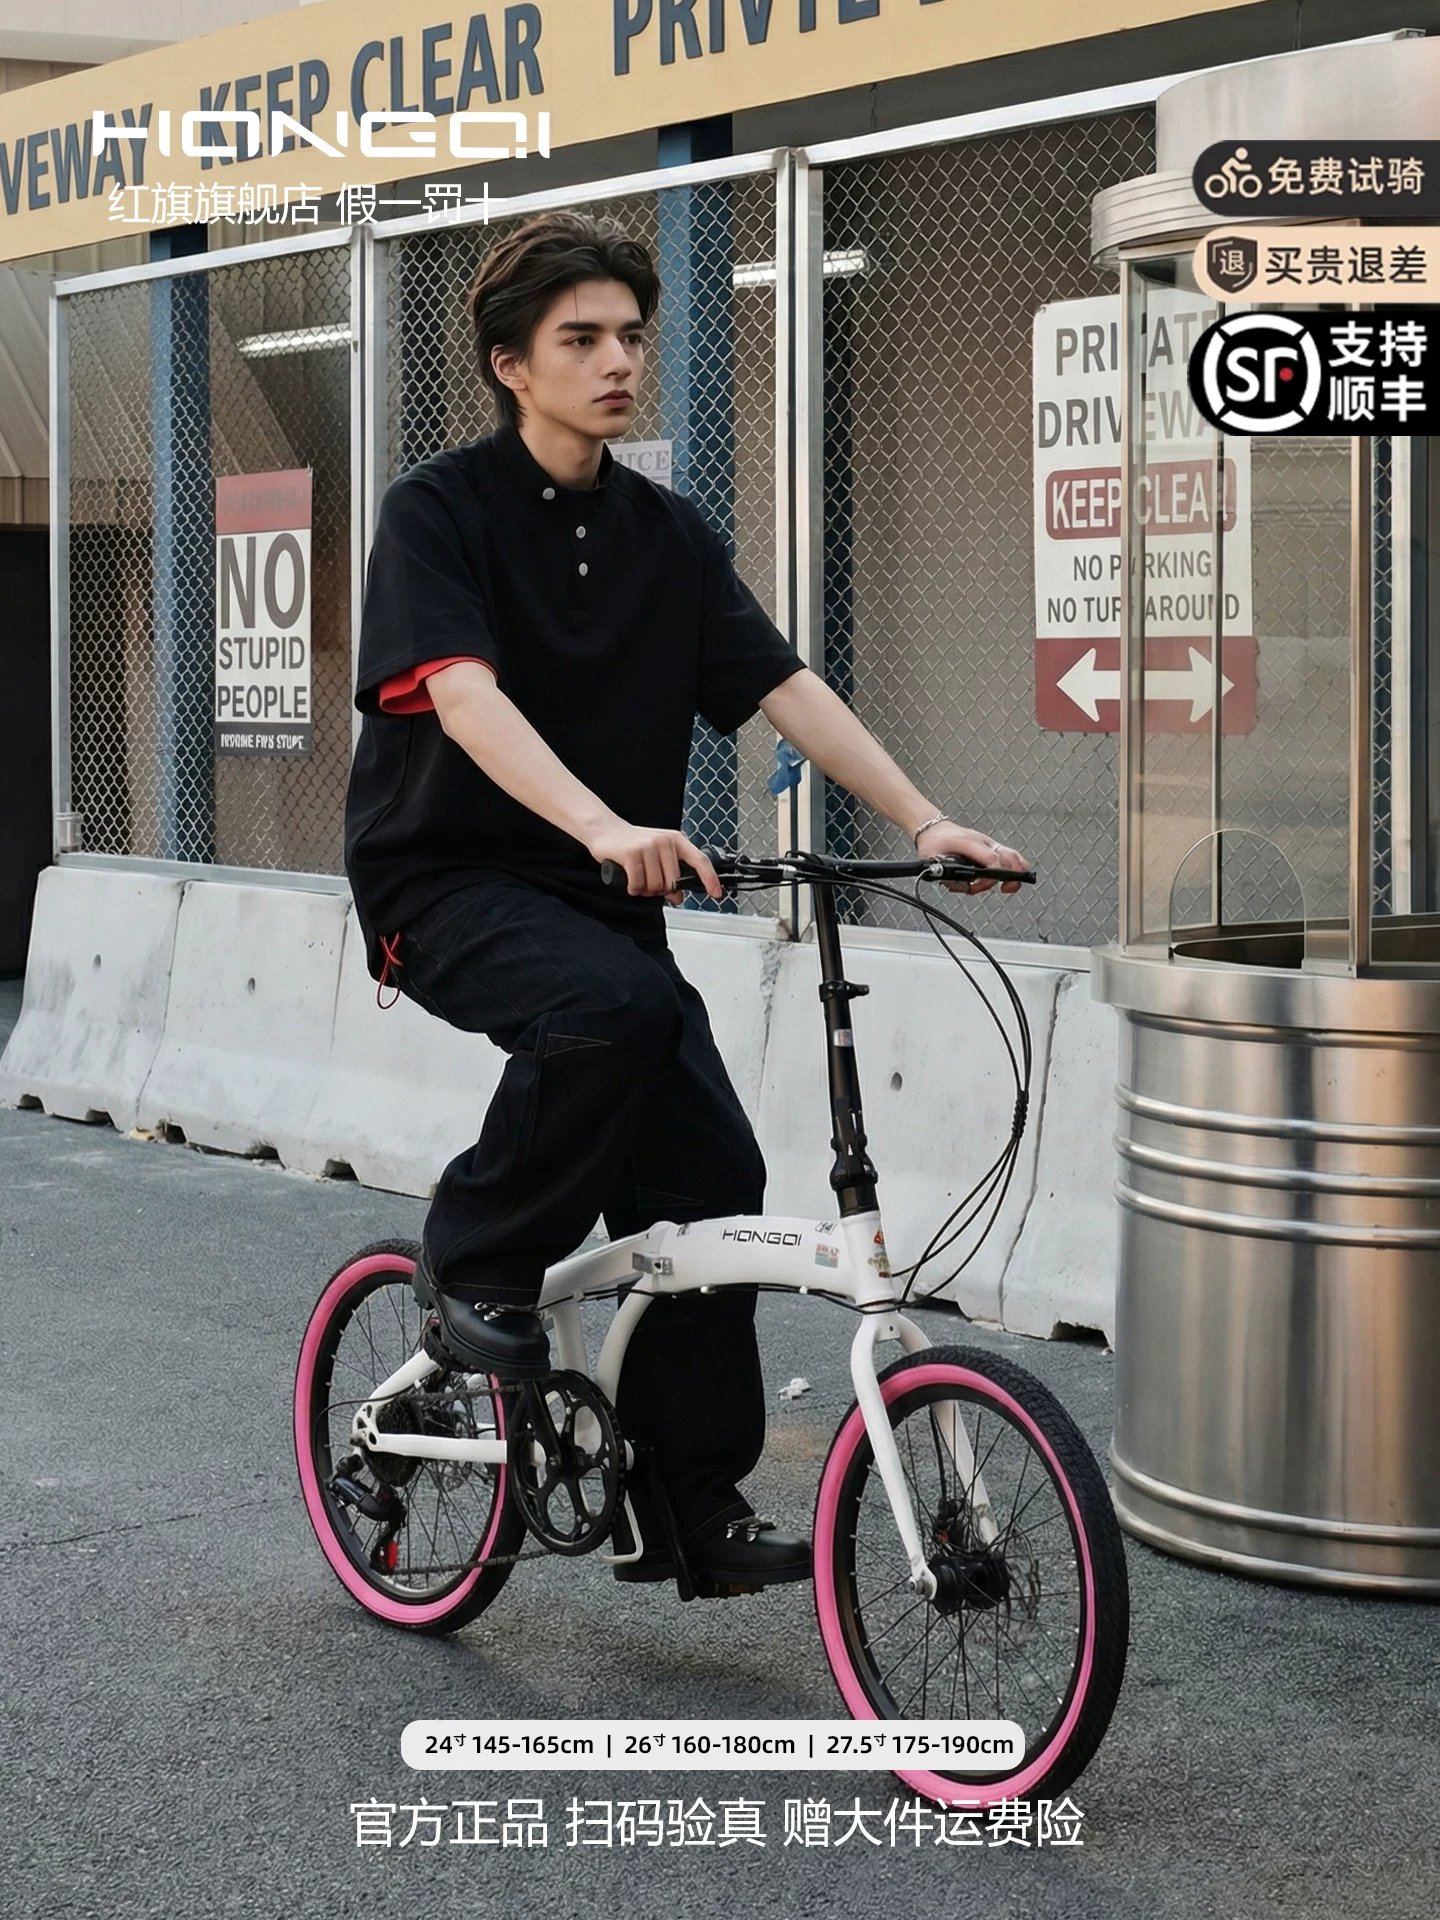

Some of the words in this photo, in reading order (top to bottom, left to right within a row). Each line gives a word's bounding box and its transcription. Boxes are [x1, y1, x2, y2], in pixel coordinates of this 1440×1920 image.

[200, 59, 330, 171] KEEP
[350, 2, 544, 132] CLEAR
[1056, 309, 1217, 376] PRIAT
[1053, 478, 1122, 529] KEEP
[1135, 471, 1228, 525] CLEA
[219, 532, 306, 630] NO
[1073, 555, 1103, 581] NO
[1110, 550, 1213, 580] PRKING
[1048, 597, 1077, 623] NO
[218, 635, 305, 670] STUPID
[217, 685, 308, 718] PEOPLE
[722, 1229, 802, 1246] HONGQI
